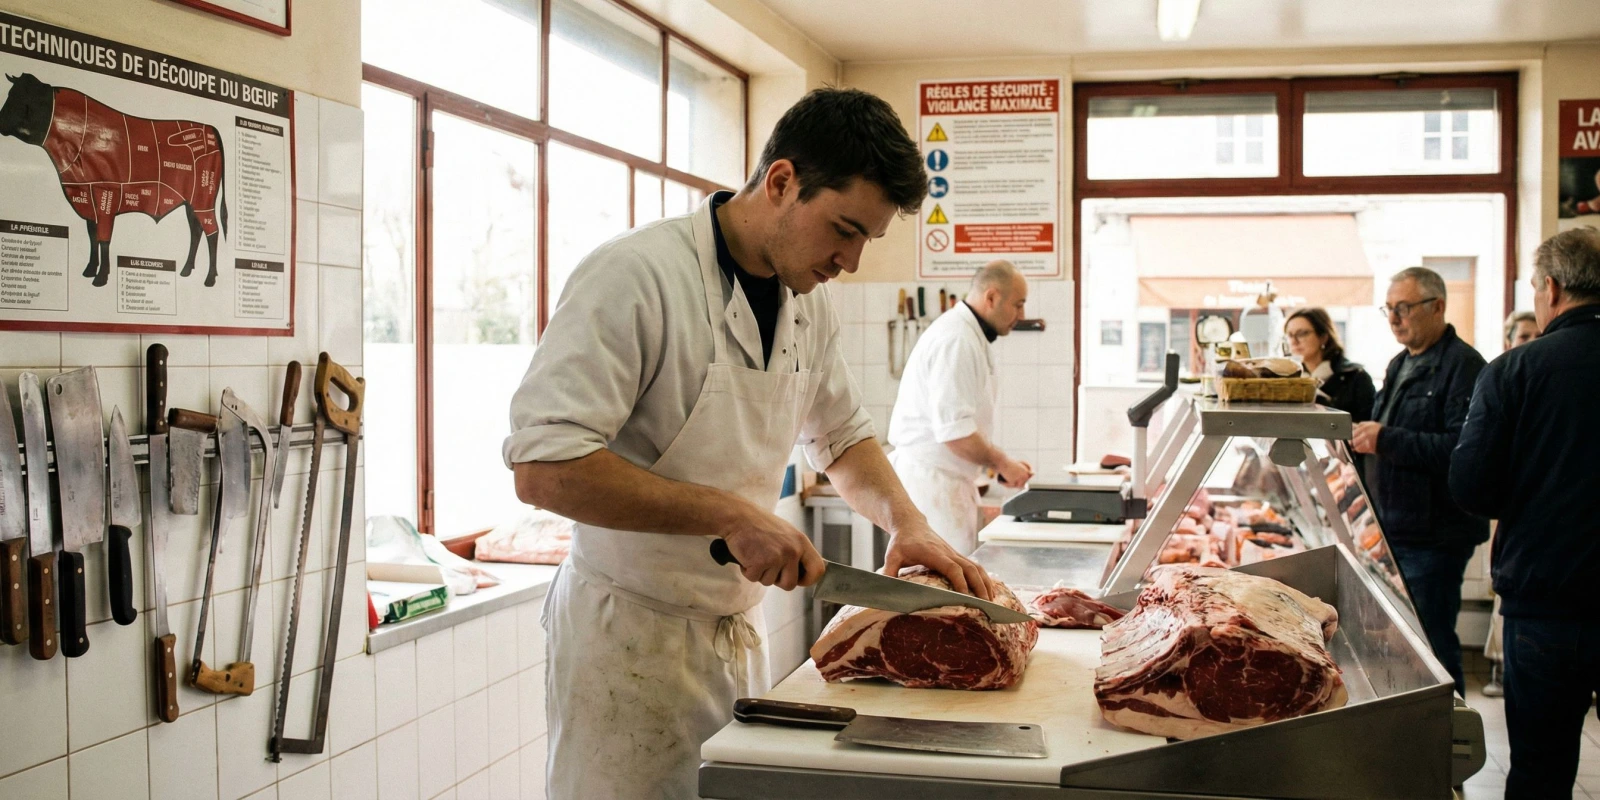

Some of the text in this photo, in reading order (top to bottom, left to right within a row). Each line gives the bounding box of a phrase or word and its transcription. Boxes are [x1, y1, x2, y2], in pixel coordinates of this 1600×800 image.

[0, 22, 279, 109] TECHNIQUES DE DÉCOUPE DU BŒUF
[926, 85, 969, 99] RÈGLES
[972, 85, 988, 98] DE
[990, 81, 1047, 97] SÉCURITÉ
[927, 97, 1053, 113] VIGILANCE MAXIMALE
[1578, 107, 1600, 127] LA
[1573, 131, 1600, 150] AV
